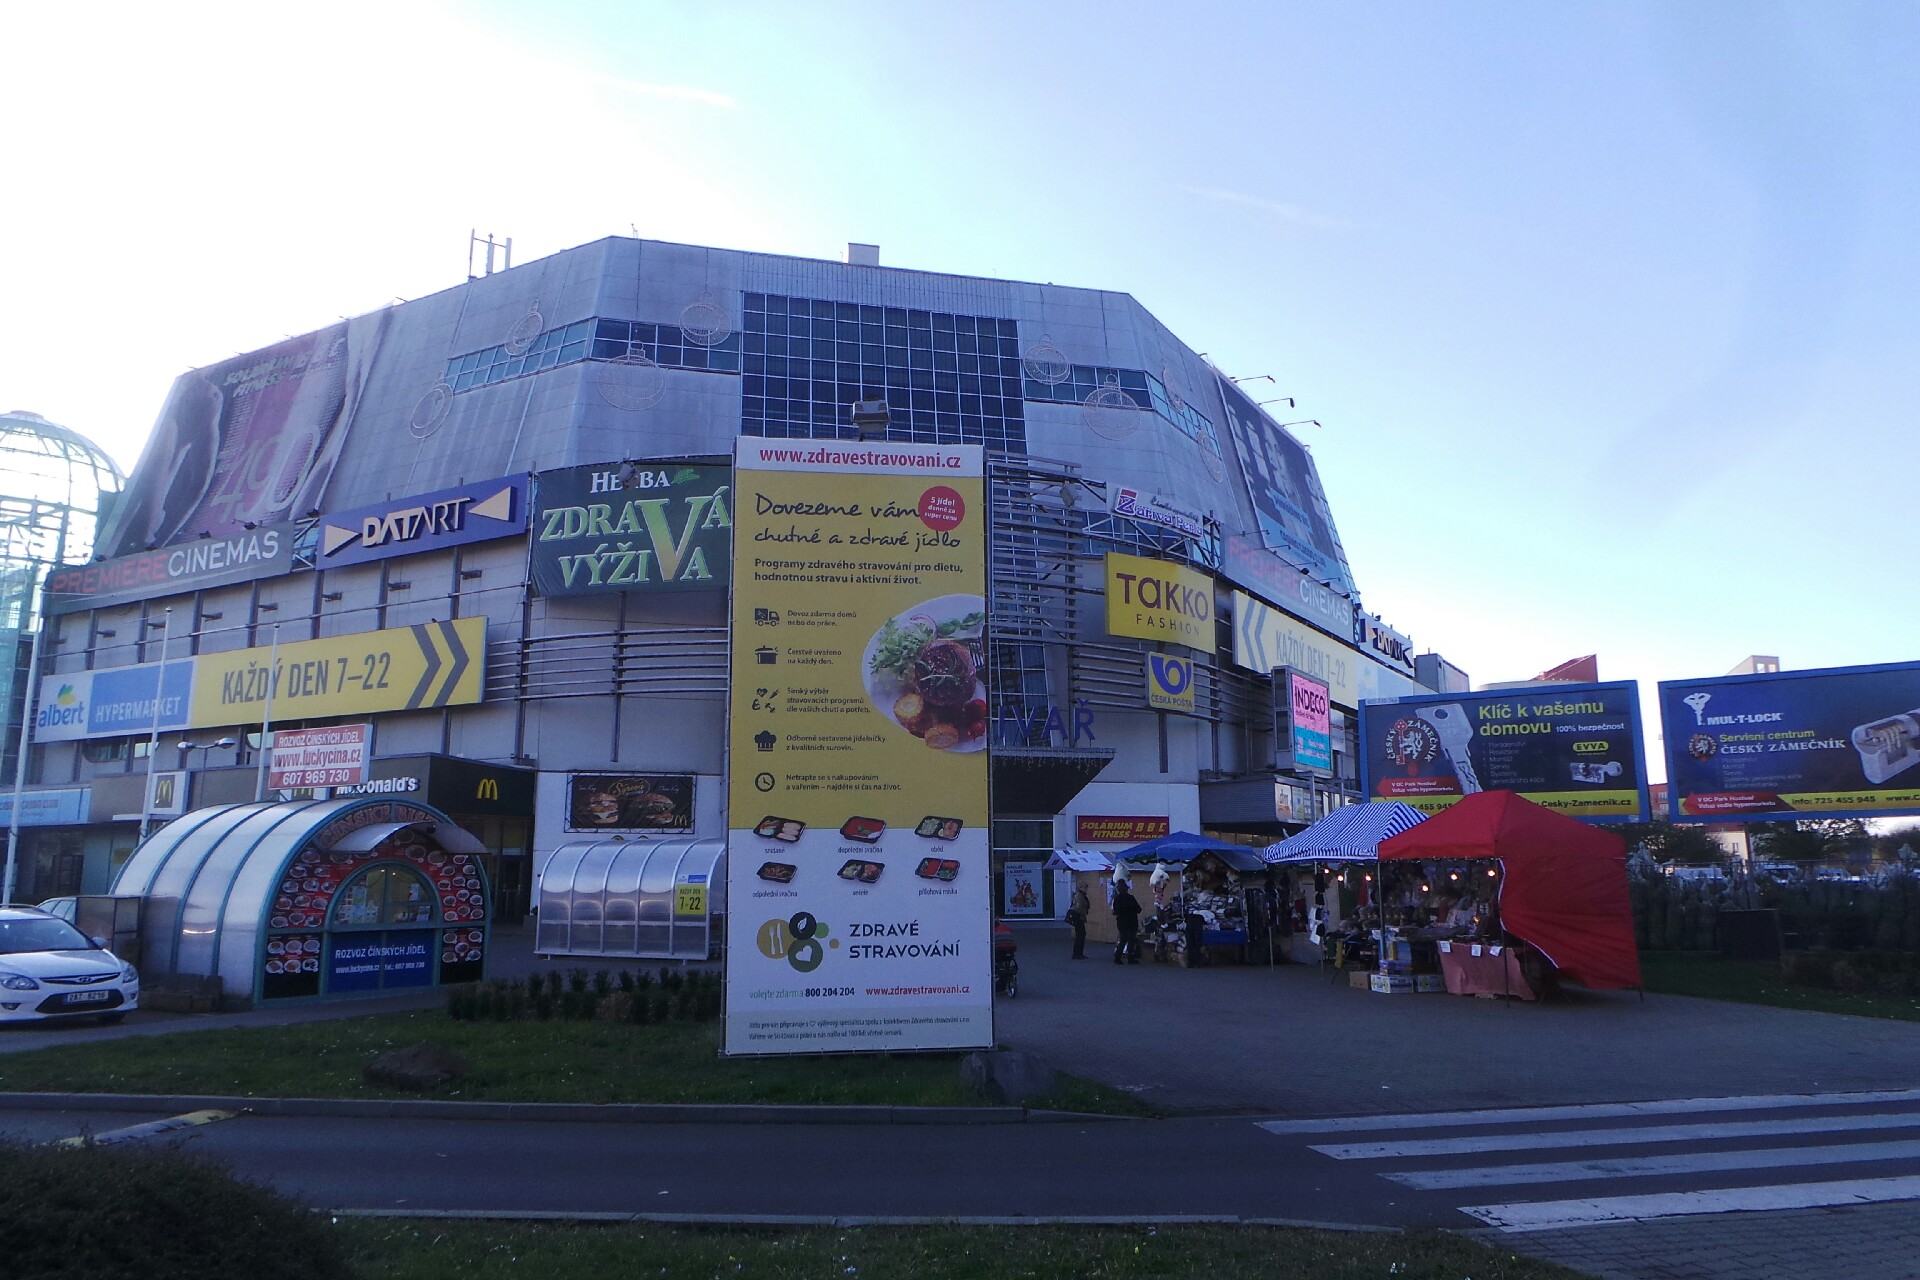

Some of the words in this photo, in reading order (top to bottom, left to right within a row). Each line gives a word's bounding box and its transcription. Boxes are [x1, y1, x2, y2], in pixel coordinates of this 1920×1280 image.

[760, 448, 961, 469] www.zdravestravovani.cz
[590, 470, 671, 493] HEBA
[755, 493, 862, 518] Dovezeme
[871, 501, 920, 518] vám
[938, 497, 955, 507] jídel
[362, 497, 472, 547] DATART
[754, 525, 821, 544] chutné
[828, 534, 843, 545] a
[849, 528, 909, 546] zdravé
[915, 530, 961, 552] jídlo
[52, 554, 168, 594] PREMIERE
[168, 531, 279, 577] CINEMAS
[754, 558, 805, 570] Programy
[807, 559, 856, 570] zdravého
[858, 560, 912, 571] stravování
[914, 564, 931, 573] pro
[933, 562, 963, 573] dietu,
[754, 572, 813, 582] hodnotnou
[815, 574, 848, 583] stravu
[850, 573, 854, 583] i
[856, 573, 891, 584] aktivní
[893, 573, 922, 584] život.
[1299, 579, 1349, 626] CINEMAS
[1136, 613, 1200, 636] FASHION
[797, 657, 817, 665] každý
[1275, 628, 1304, 671] KAŽDÝ
[1307, 645, 1324, 678] DEN
[222, 657, 283, 704] KAŽDÝ
[288, 660, 329, 698] DEN
[95, 697, 181, 722] HYPERMARKET
[1151, 694, 1171, 705] ČESKÁ
[1172, 696, 1193, 707] POŠTA
[1294, 685, 1326, 715] INDECO
[38, 702, 84, 728] albert
[1479, 703, 1512, 720] Klíč
[1517, 703, 1527, 718] k
[1533, 701, 1604, 716] vašemu
[1707, 713, 1782, 726] MUL-T-LOCK
[278, 734, 305, 748] ROZVOZ
[307, 730, 340, 746] ČÍNSKÝCH
[341, 729, 359, 743] JÍDEL
[1479, 722, 1551, 737] domovu
[1555, 724, 1576, 733] 100%
[1578, 722, 1625, 732] bezpečnost
[1720, 732, 1765, 743] Servisní
[1767, 730, 1815, 740] centrum
[1385, 728, 1396, 760] ČESKÝ
[1407, 719, 1438, 762] ZÁMEČNÍK
[1720, 743, 1763, 755] ČESKÝ
[1768, 738, 1846, 752] ZÁMEČNÍK
[273, 747, 361, 768] www.luckycina.cz
[282, 771, 303, 785] 607
[304, 770, 325, 784] 969
[329, 769, 350, 783] 730
[1092, 830, 1130, 839] FITNESS
[849, 919, 919, 937] ZDRAVÉ
[335, 949, 366, 959] ROZVOZ
[405, 944, 426, 954] JÍDEL
[849, 939, 961, 958] STRAVOVÁNÍ
[749, 989, 775, 1000] volejte
[776, 989, 803, 998] zdarma
[805, 988, 820, 997] 800
[822, 987, 838, 996] 204
[839, 987, 855, 996] 204
[865, 984, 970, 995] www.zdravestravovani.cz
